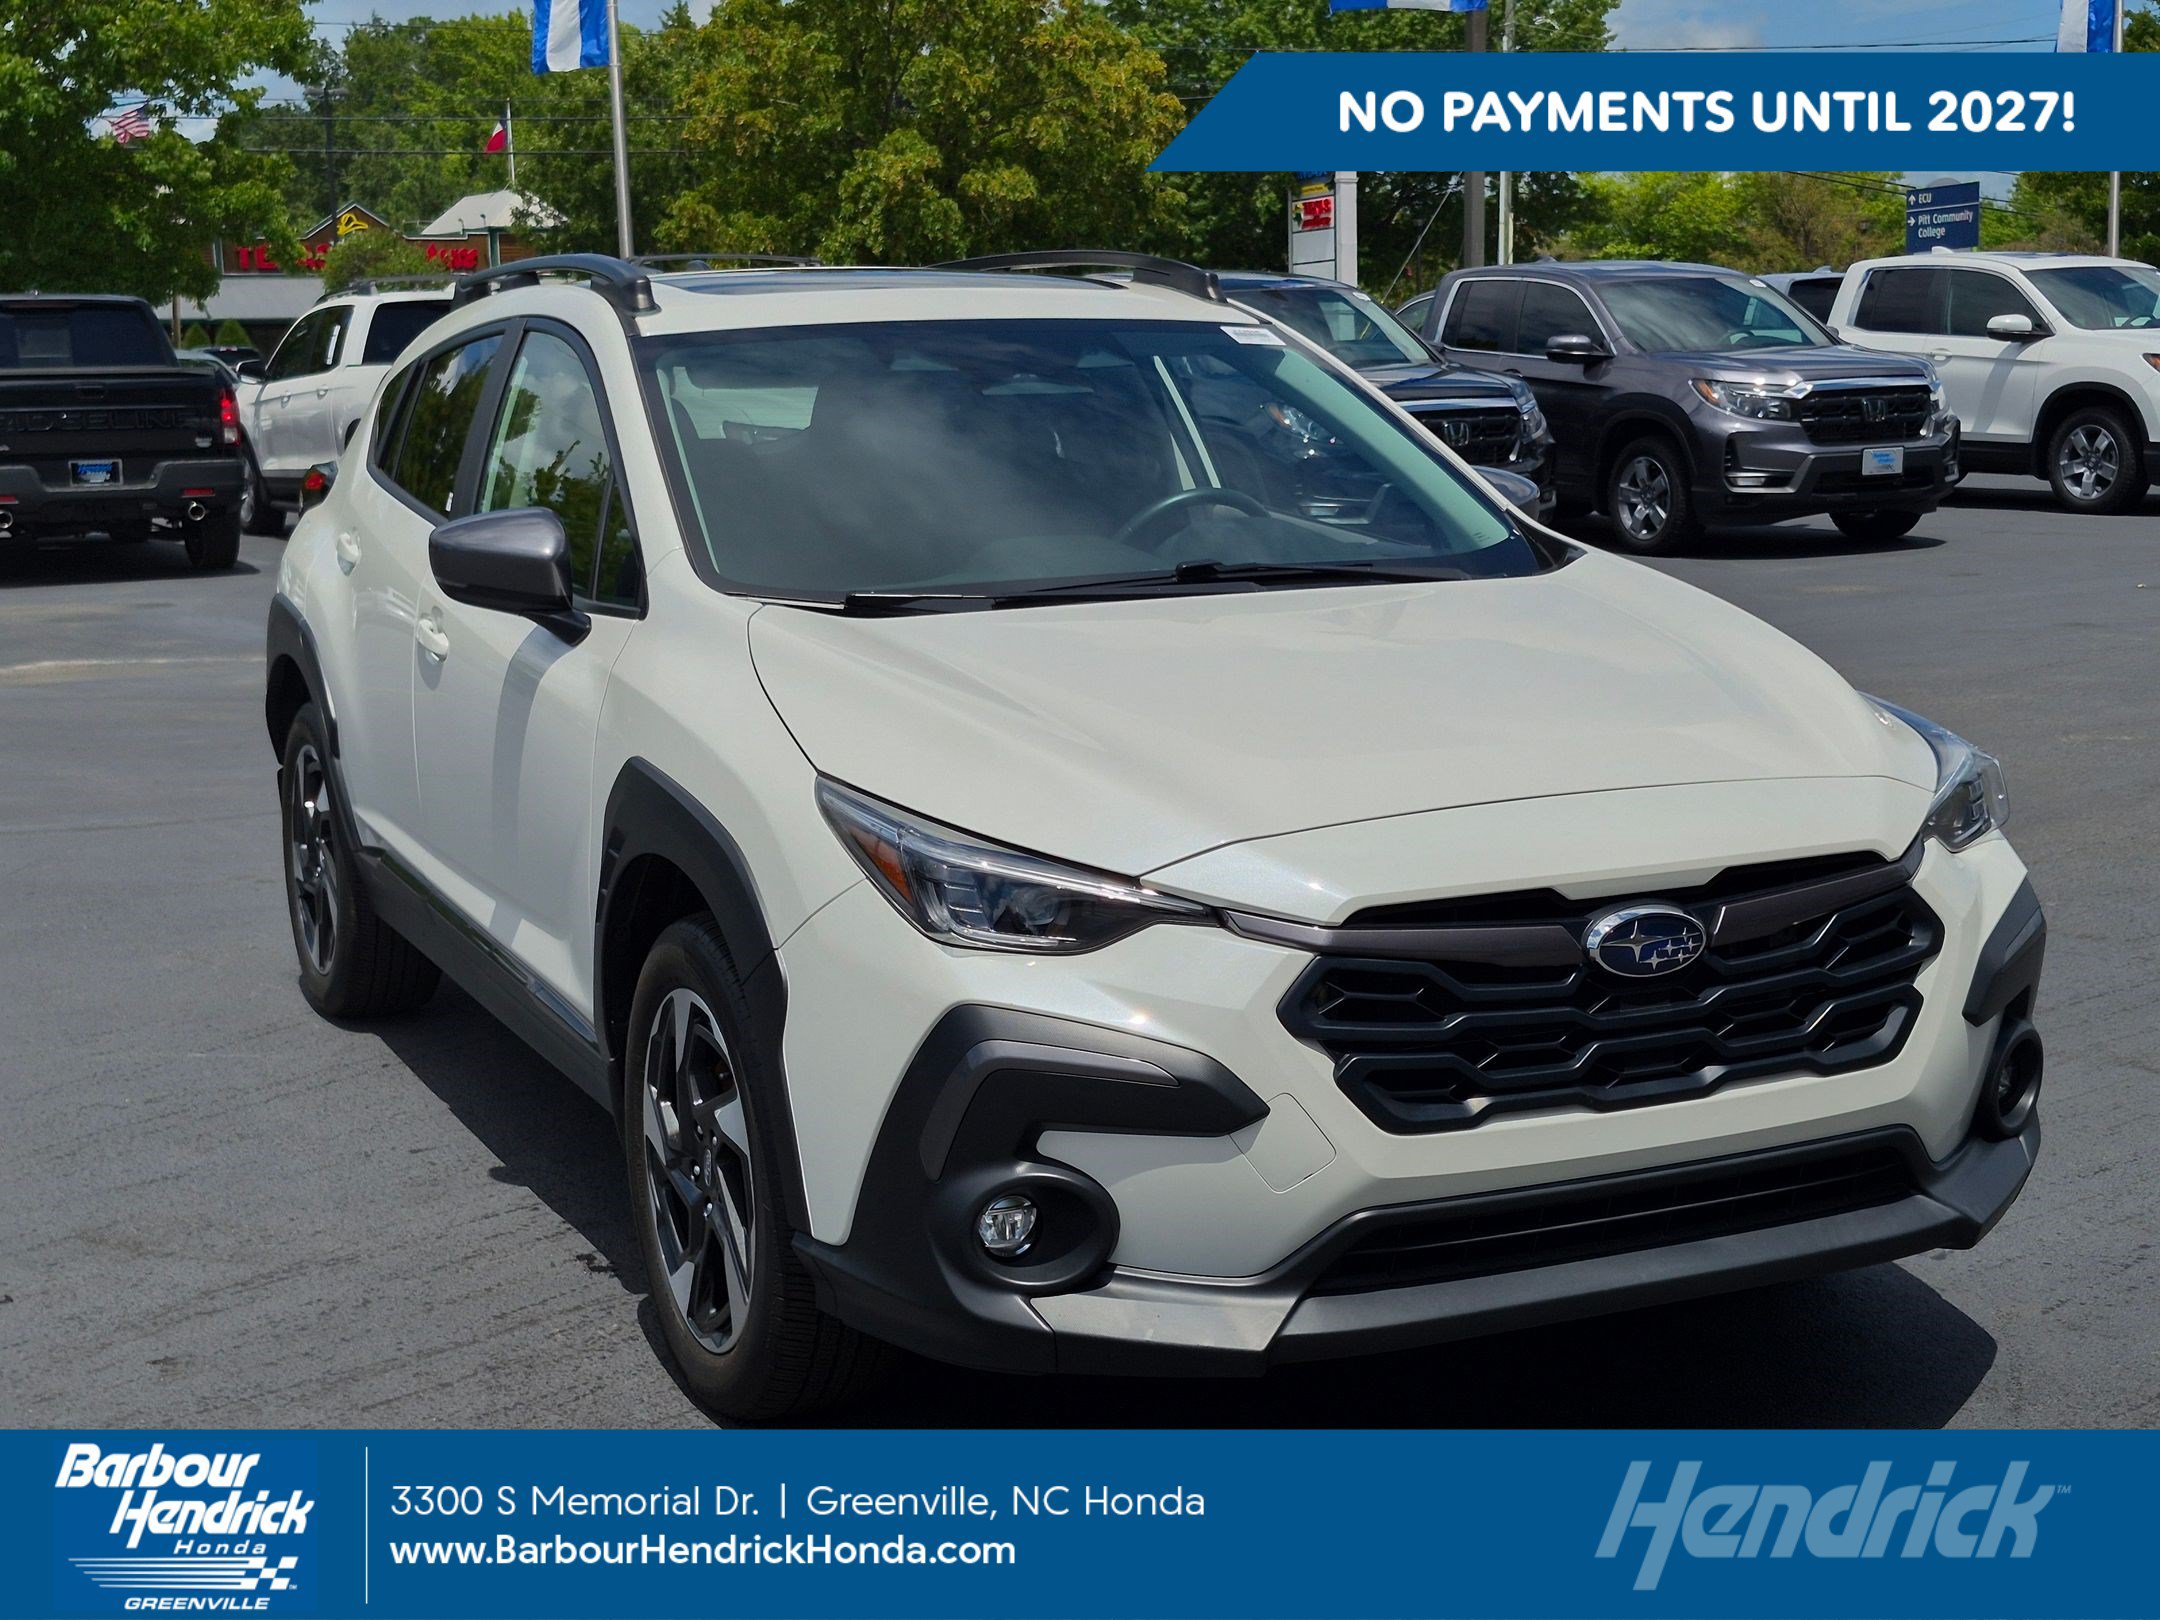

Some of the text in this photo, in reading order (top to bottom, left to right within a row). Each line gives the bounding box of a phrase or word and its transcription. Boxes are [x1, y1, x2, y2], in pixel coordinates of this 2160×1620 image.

[1918, 192, 1932, 204] ECU
[1918, 210, 1974, 225] Pitt Community
[1918, 226, 1946, 239] College
